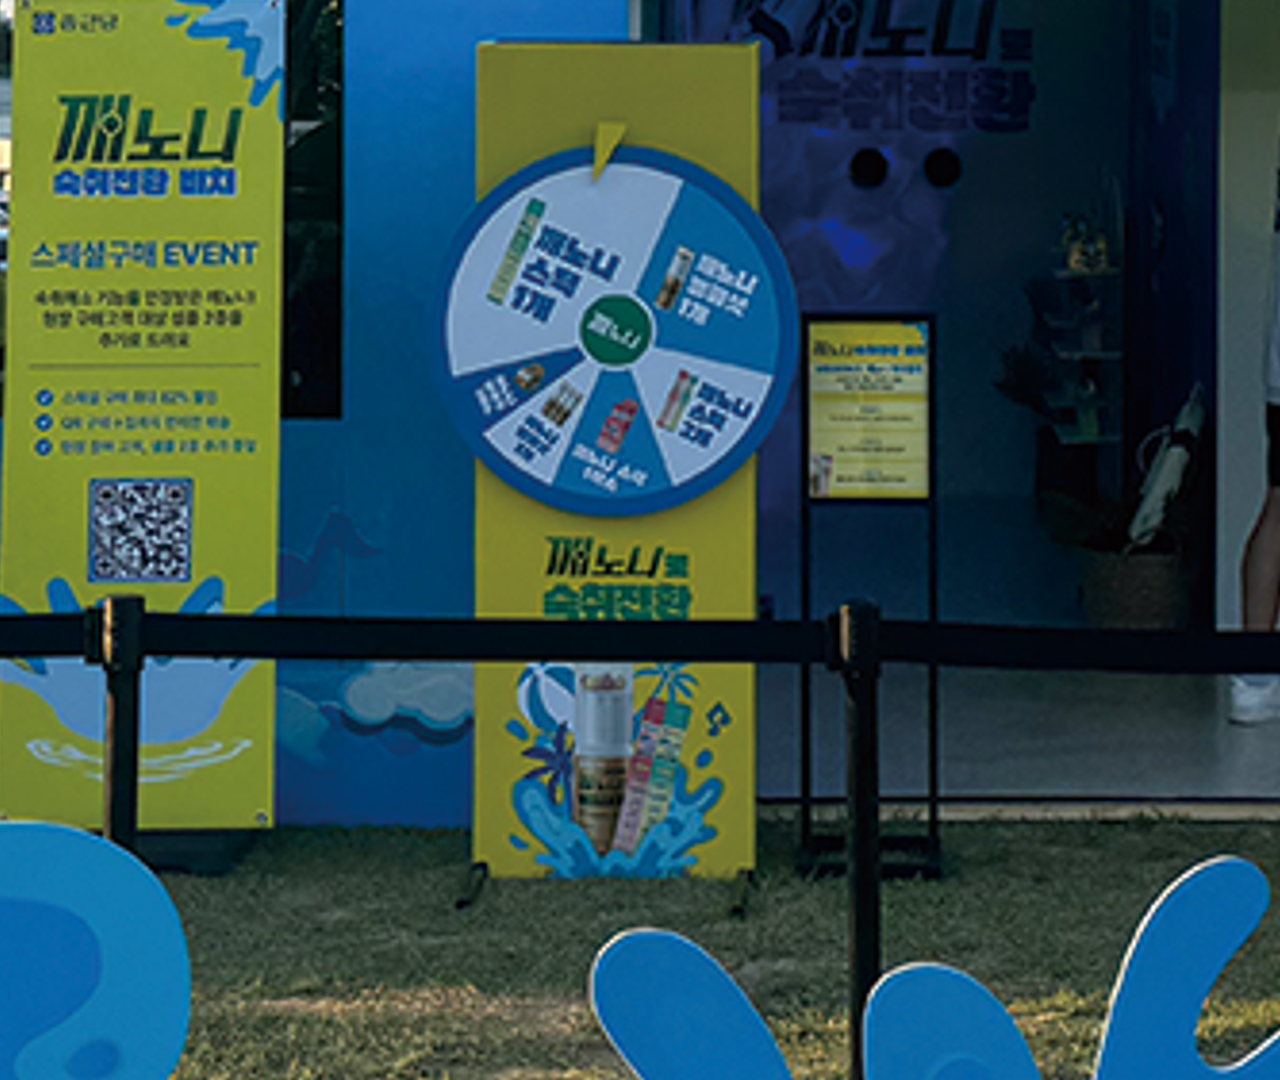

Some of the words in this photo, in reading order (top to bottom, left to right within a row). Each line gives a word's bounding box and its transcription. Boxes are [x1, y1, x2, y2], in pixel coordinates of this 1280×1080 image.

[53, 94, 243, 163] 깨노니
[164, 241, 258, 267] EVENT
[534, 225, 621, 282] 깨노니
[511, 285, 556, 322] 1개
